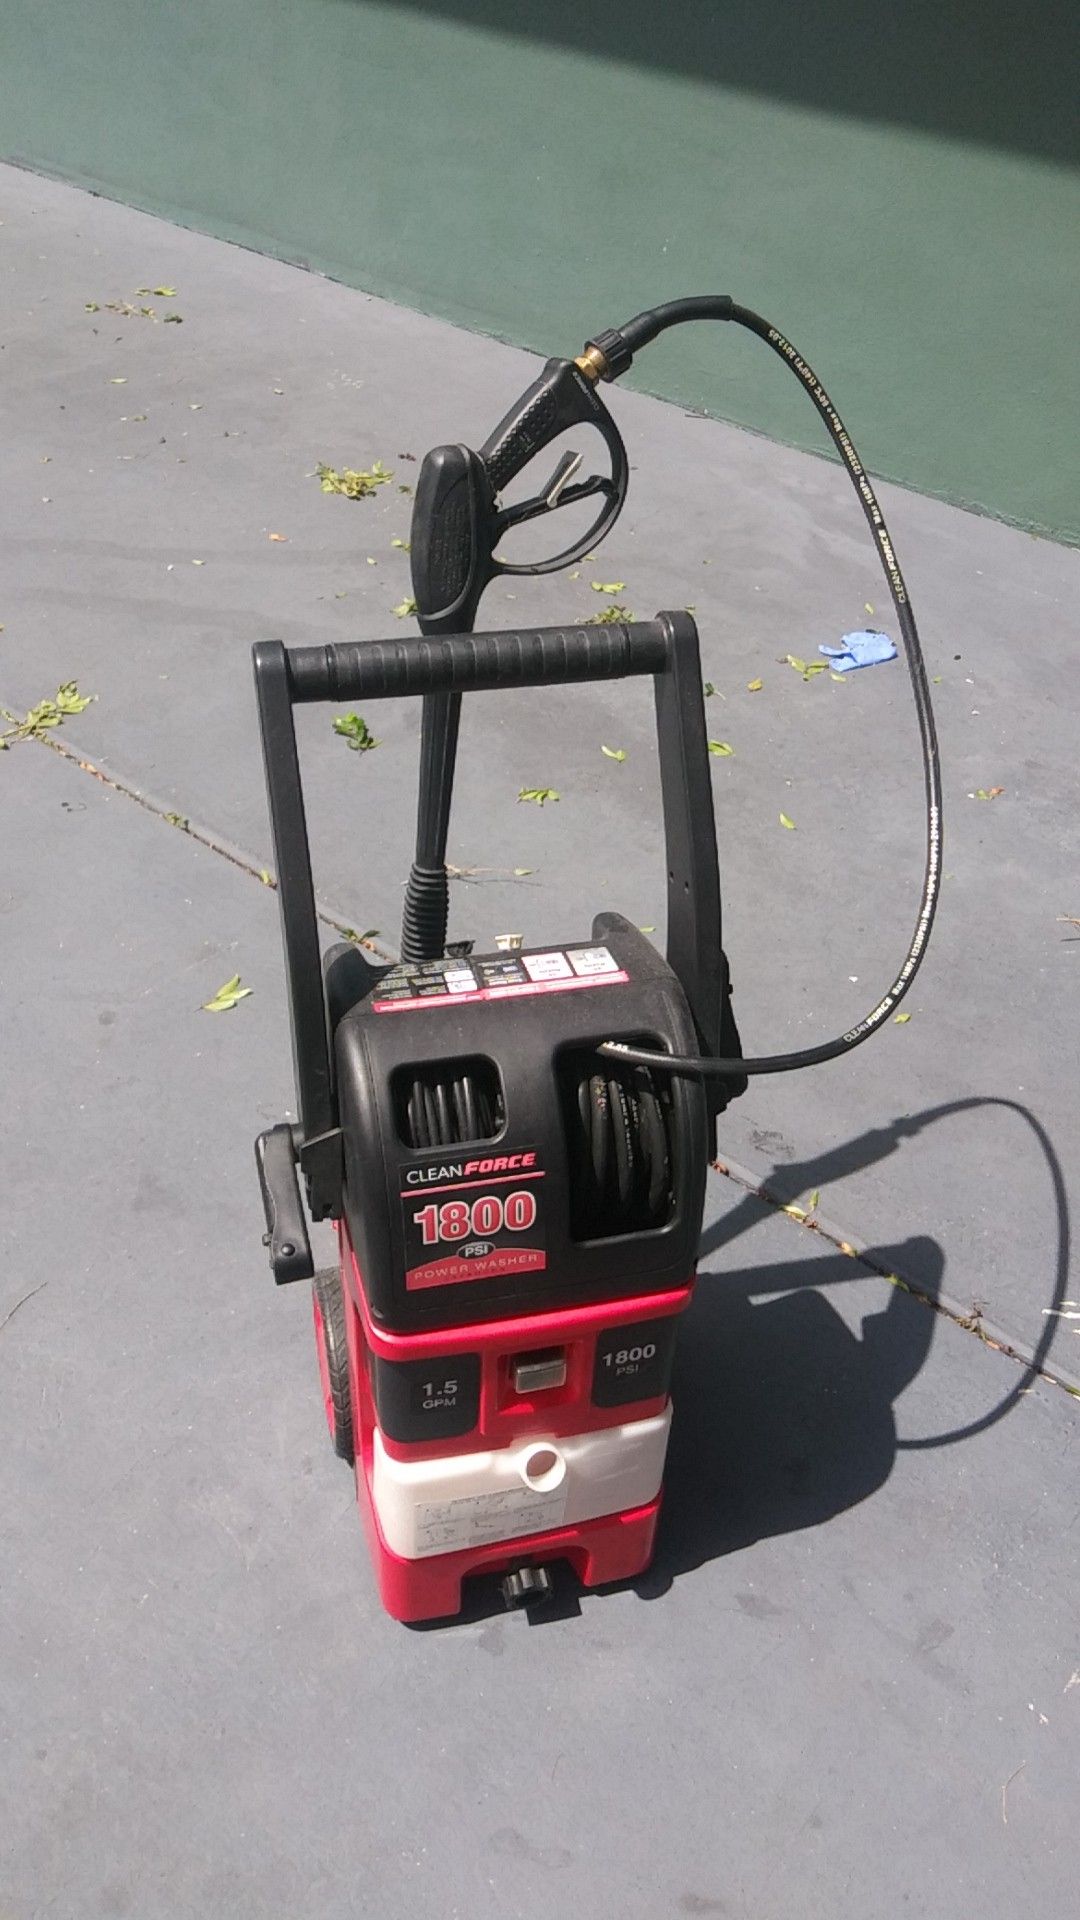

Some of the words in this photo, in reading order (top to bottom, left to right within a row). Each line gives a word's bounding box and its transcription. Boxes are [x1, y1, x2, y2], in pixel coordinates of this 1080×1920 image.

[406, 1152, 537, 1184] CLEANFORCE
[413, 1190, 537, 1245] 1800
[464, 1245, 489, 1258] PSI
[414, 1264, 469, 1280] POWER
[475, 1254, 538, 1271] WASHER
[602, 1344, 656, 1367] 1800
[616, 1364, 639, 1377] PSI
[422, 1380, 458, 1397] 1.5
[422, 1397, 456, 1409] GPM
